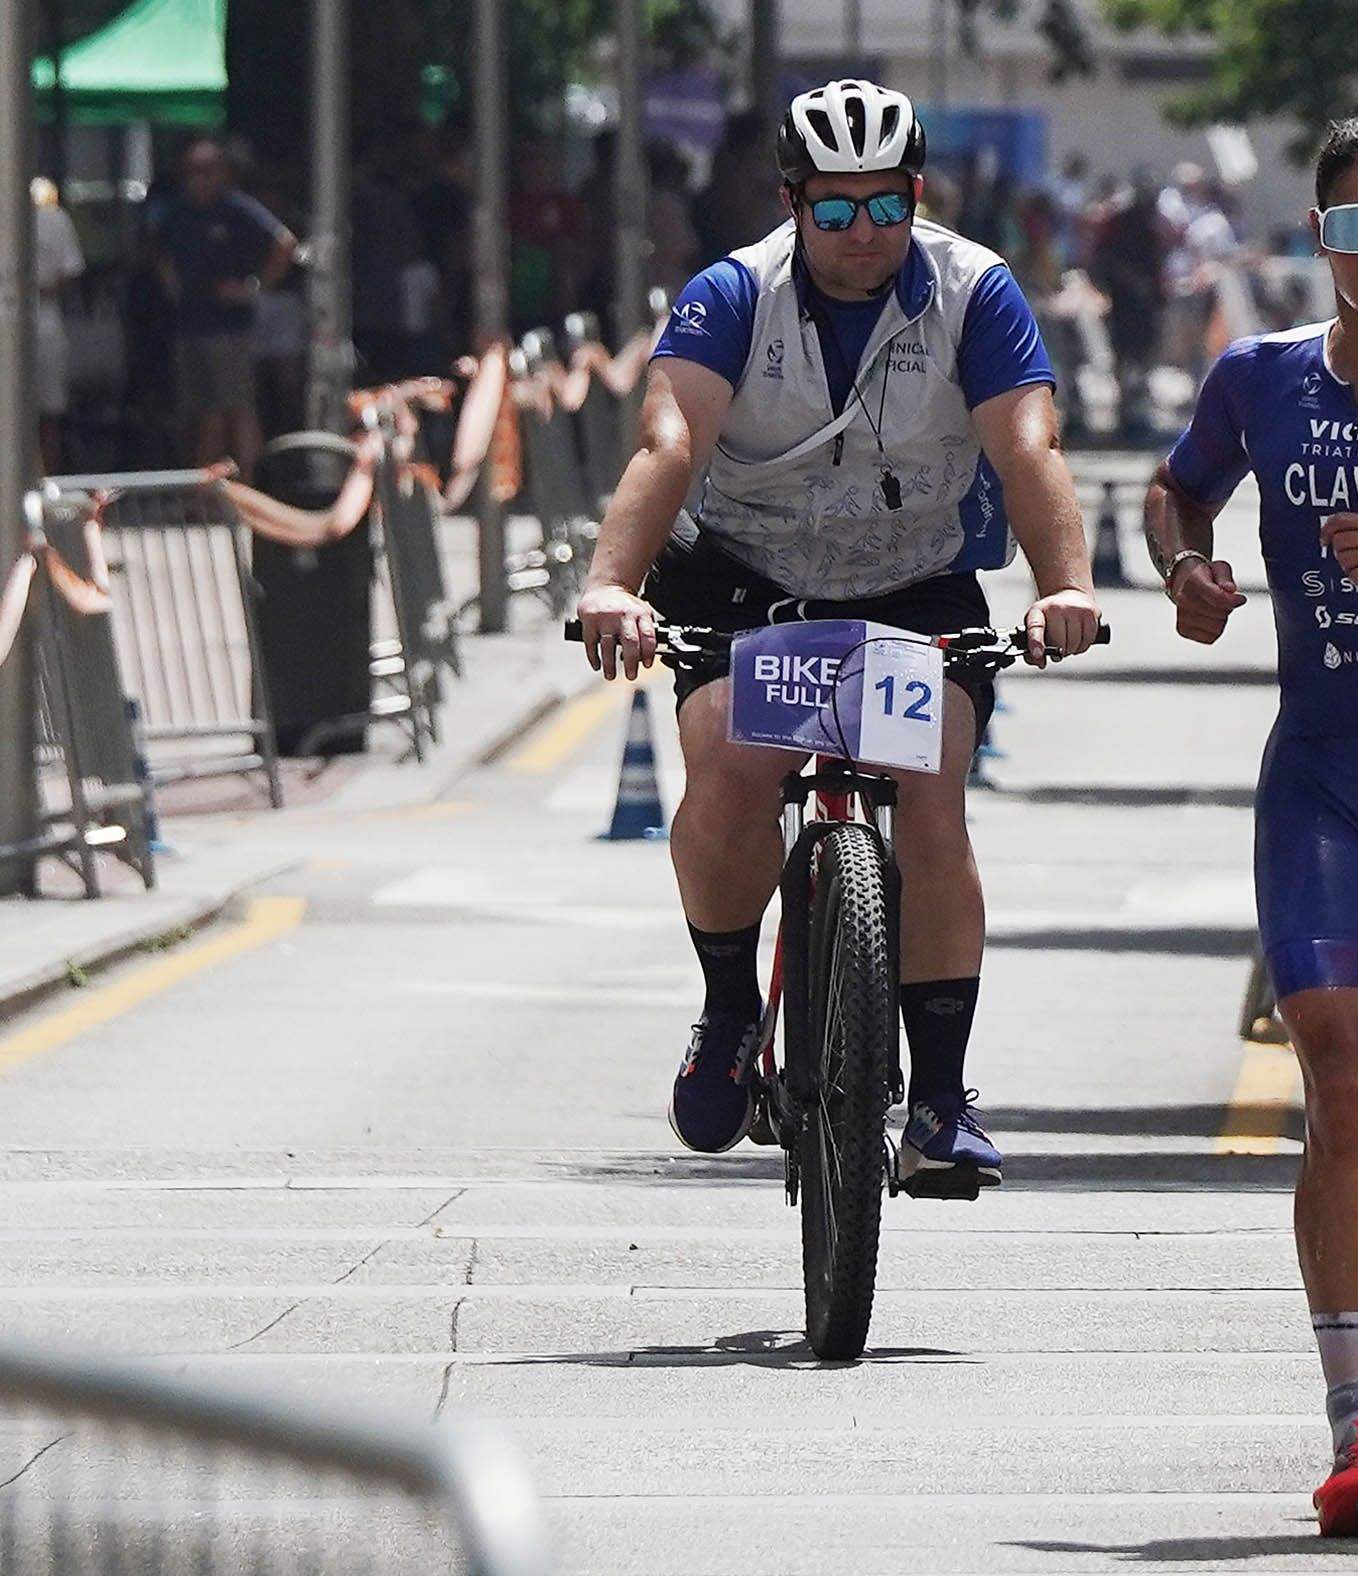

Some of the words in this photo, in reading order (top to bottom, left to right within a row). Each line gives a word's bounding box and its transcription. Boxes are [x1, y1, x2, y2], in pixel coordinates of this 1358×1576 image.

[754, 655, 842, 687] BIKE
[766, 684, 829, 709] FULL
[875, 675, 933, 722] 12
